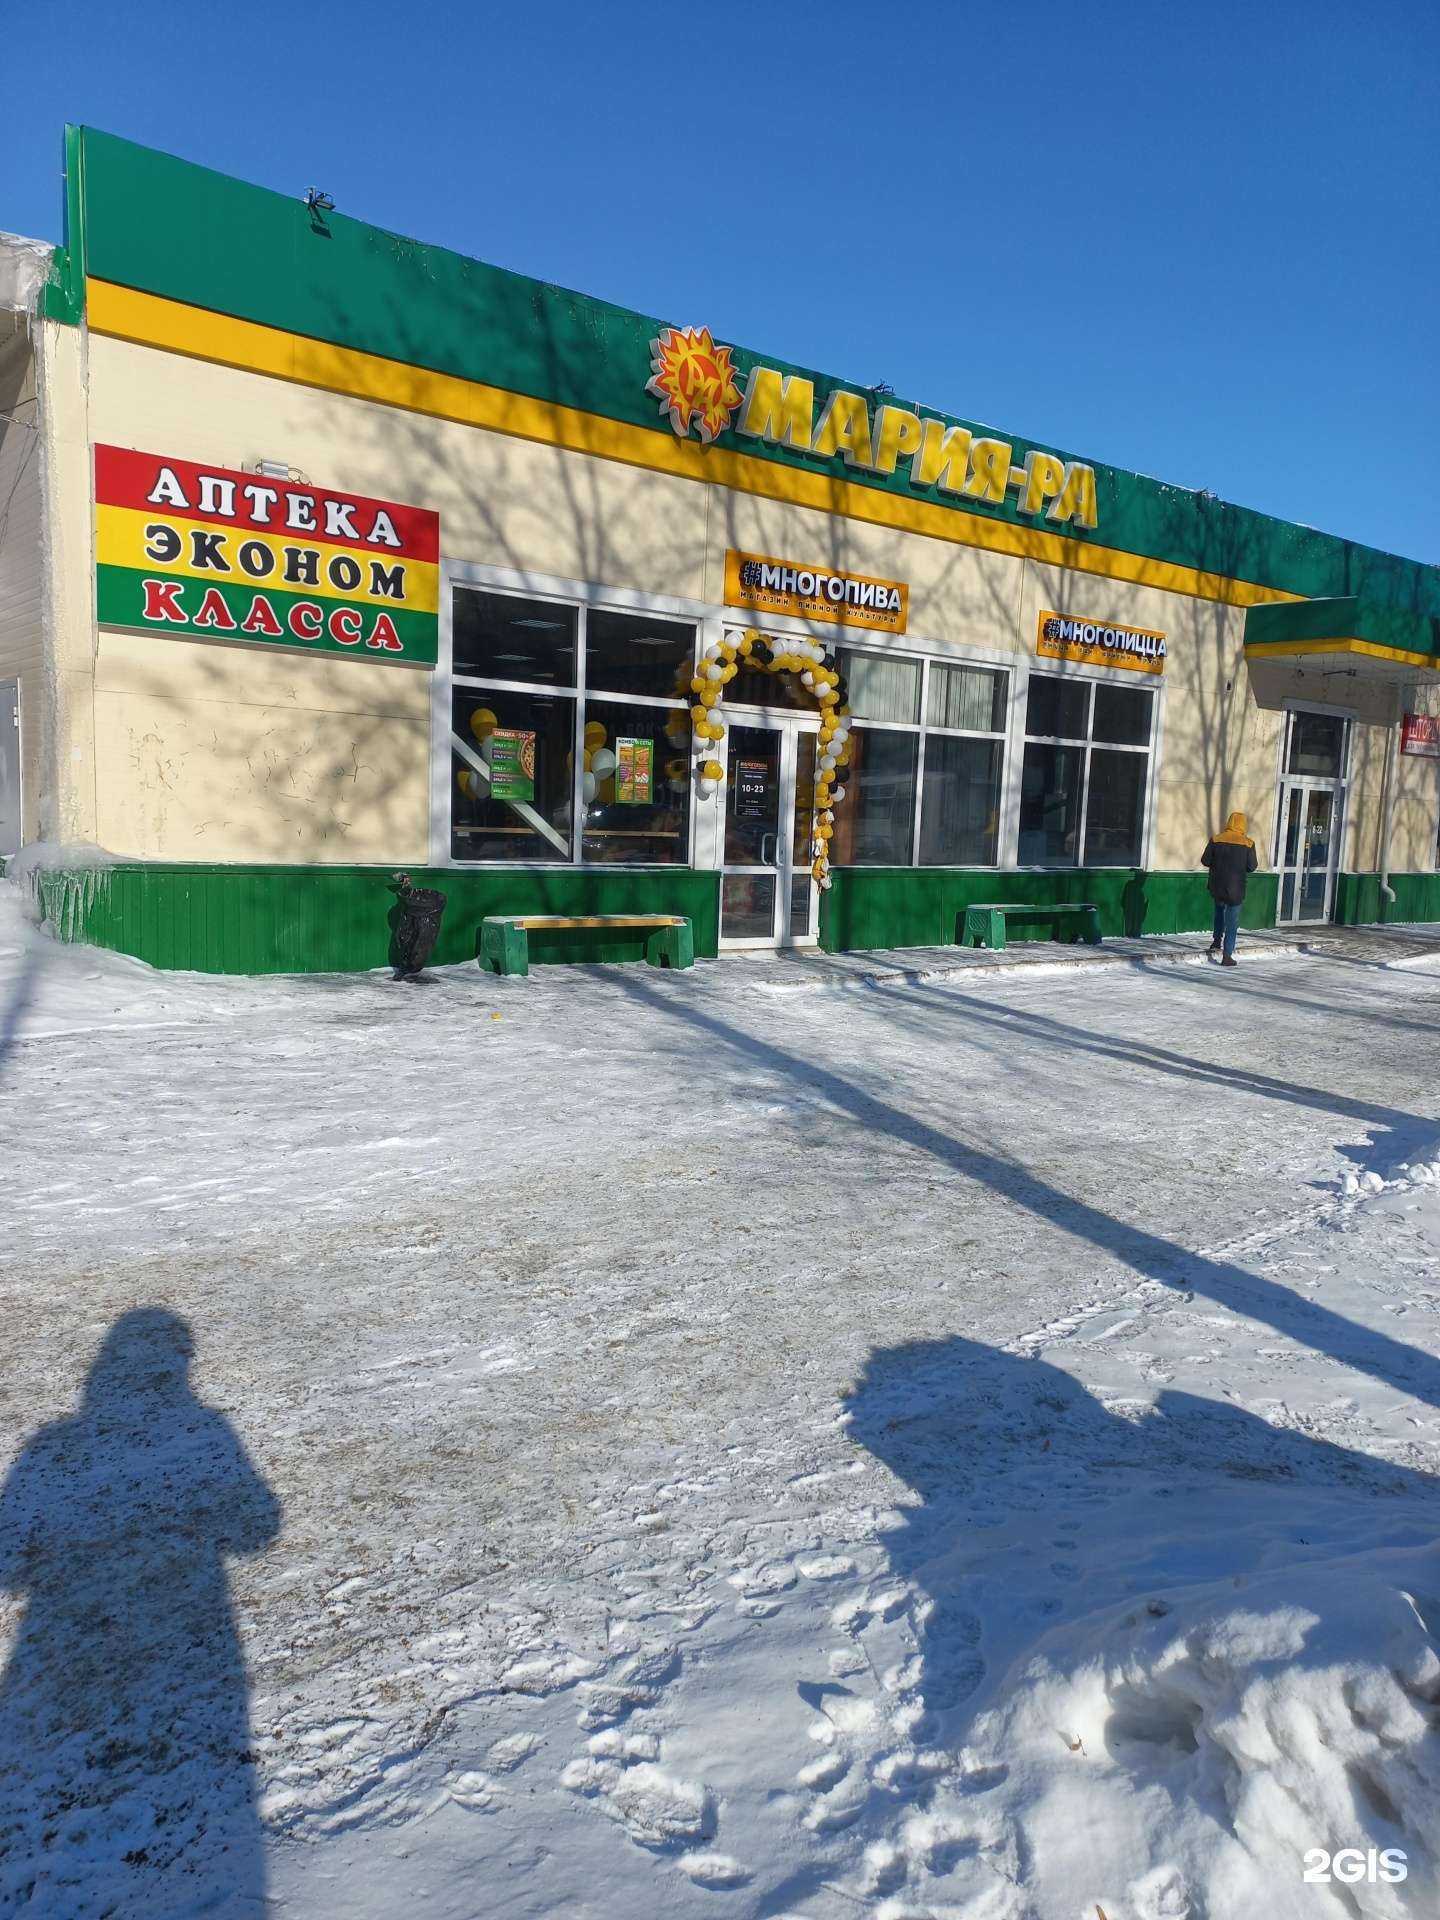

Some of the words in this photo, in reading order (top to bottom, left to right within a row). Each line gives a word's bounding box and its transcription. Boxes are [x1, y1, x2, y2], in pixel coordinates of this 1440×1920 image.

[736, 366, 1098, 530] МАРИЯ-РА
[147, 467, 403, 548] АПТЕКА
[144, 524, 407, 601] ЭКОНОМ
[141, 579, 404, 651] КЛАССА
[739, 591, 790, 607] МАГАЗИН
[798, 600, 839, 614] ПИВНОЙ
[846, 608, 897, 624] КУЛЬТУРЫ
[741, 784, 764, 793] 10-23
